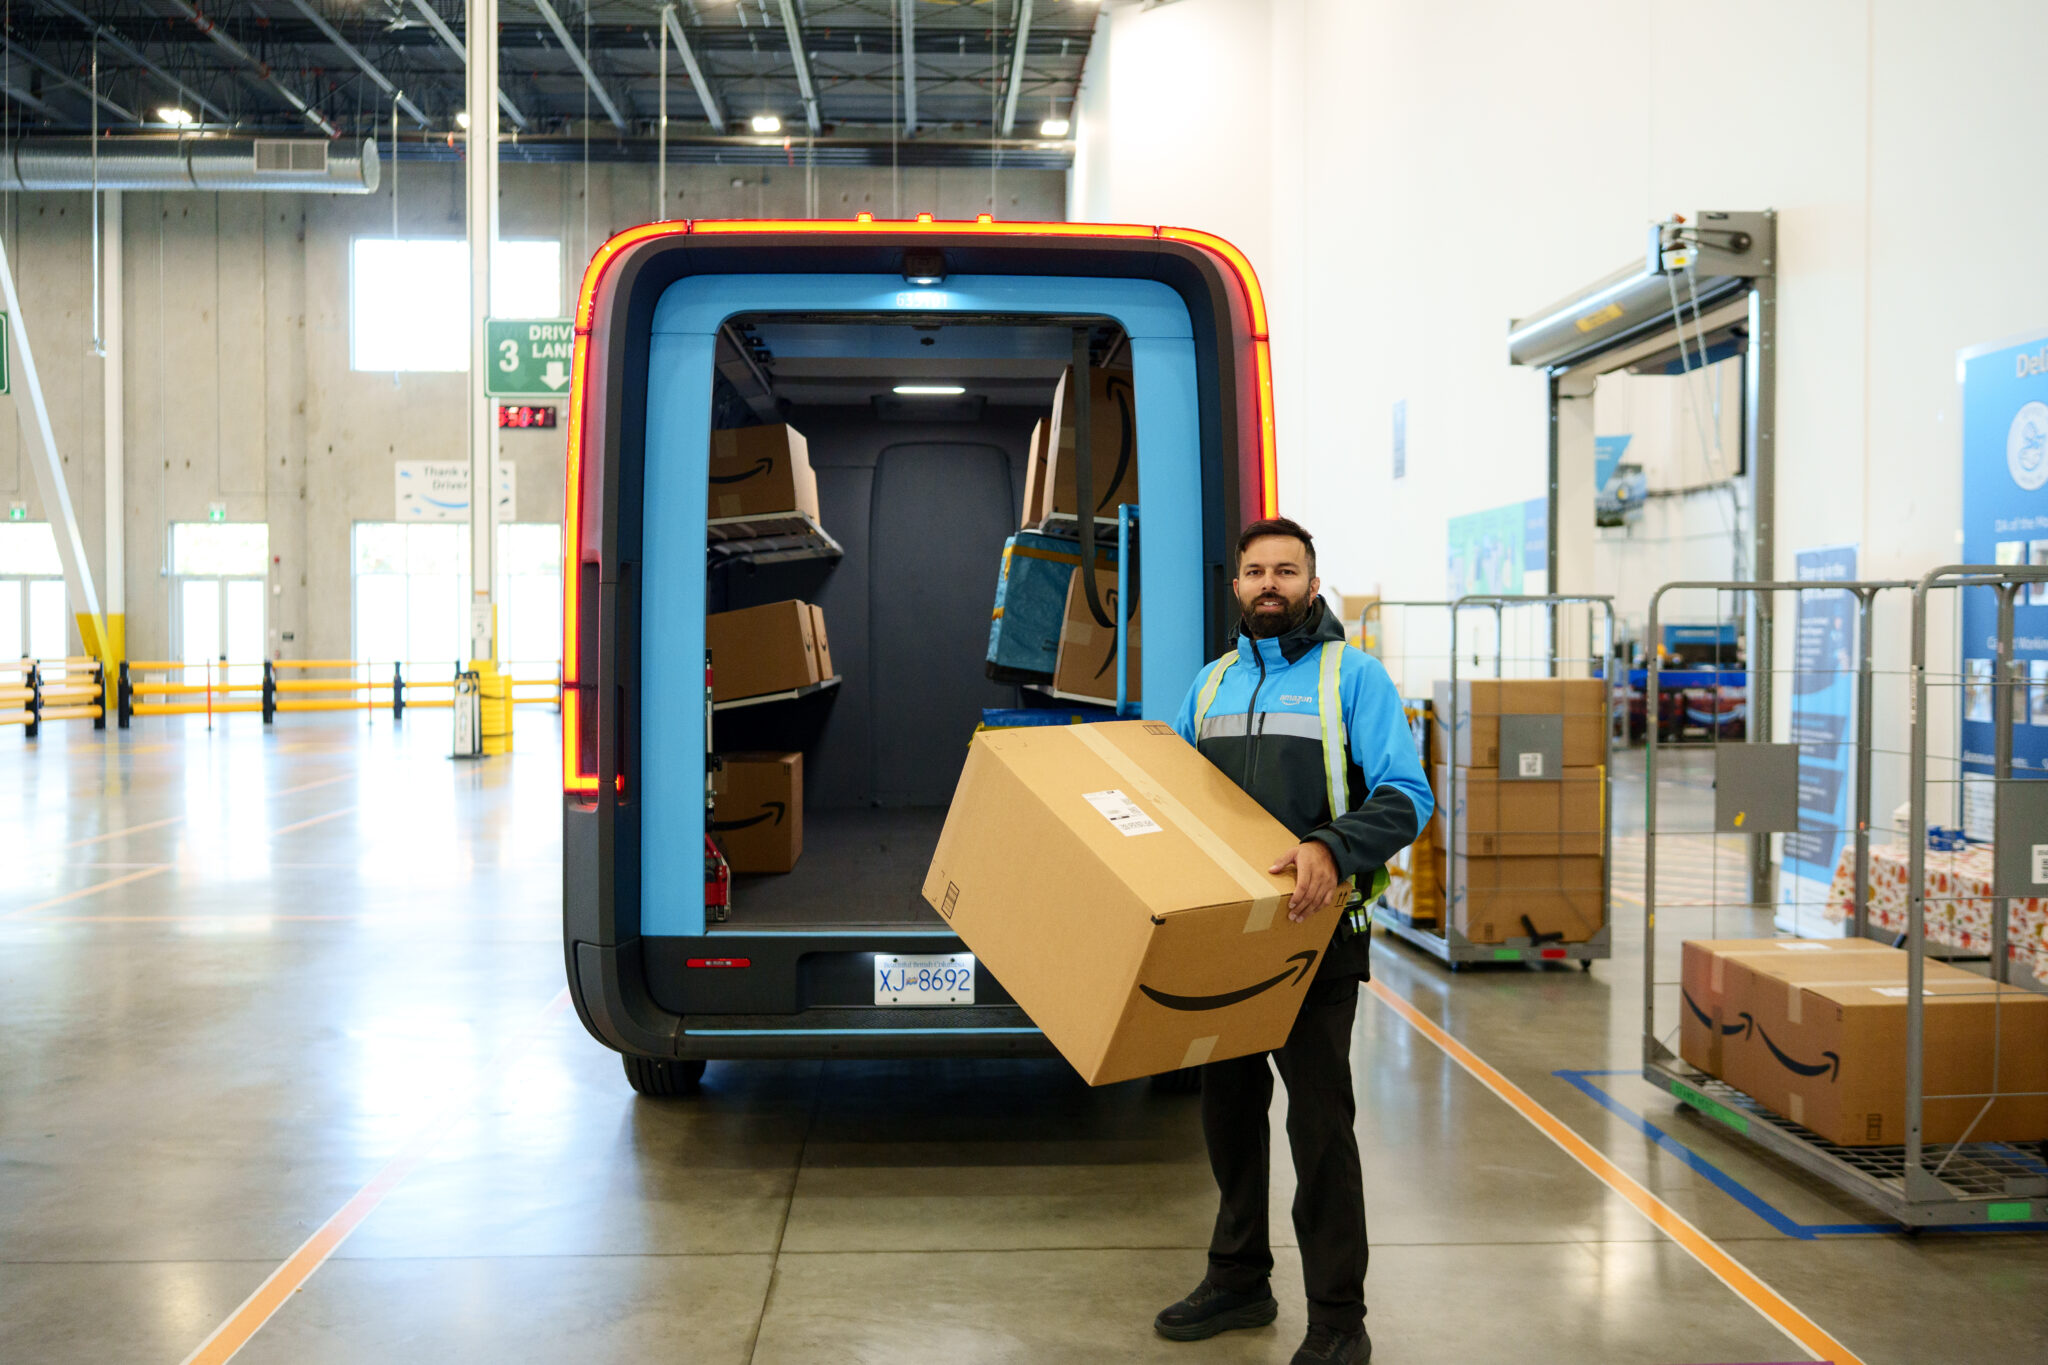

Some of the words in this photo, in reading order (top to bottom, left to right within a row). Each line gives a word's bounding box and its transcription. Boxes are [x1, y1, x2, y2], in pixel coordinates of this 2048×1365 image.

[529, 325, 574, 340] DRIV
[499, 339, 519, 372] 3
[2016, 346, 2048, 378] Del
[424, 465, 457, 477] Thank
[433, 480, 468, 491] Driver
[1280, 694, 1313, 705] amazon
